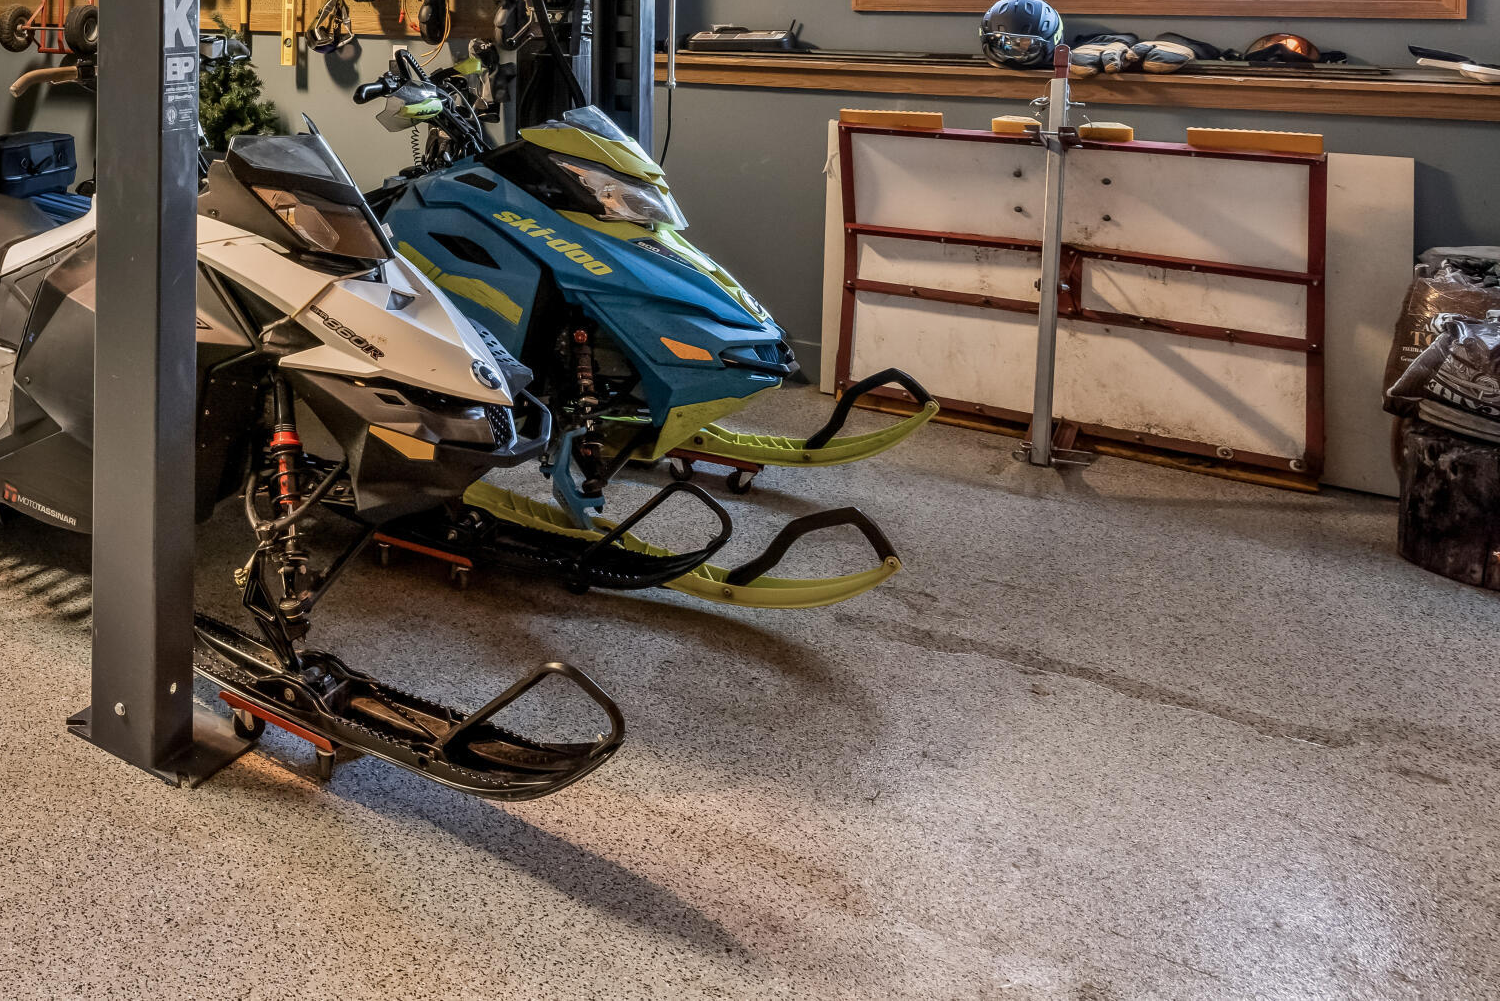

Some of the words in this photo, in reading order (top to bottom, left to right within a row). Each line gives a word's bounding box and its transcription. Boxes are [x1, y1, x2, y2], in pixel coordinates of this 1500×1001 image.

[166, 56, 195, 82] BP
[492, 211, 613, 276] ski-doo
[323, 318, 385, 361] 860R
[17, 494, 77, 527] MOTOTASSINARI
